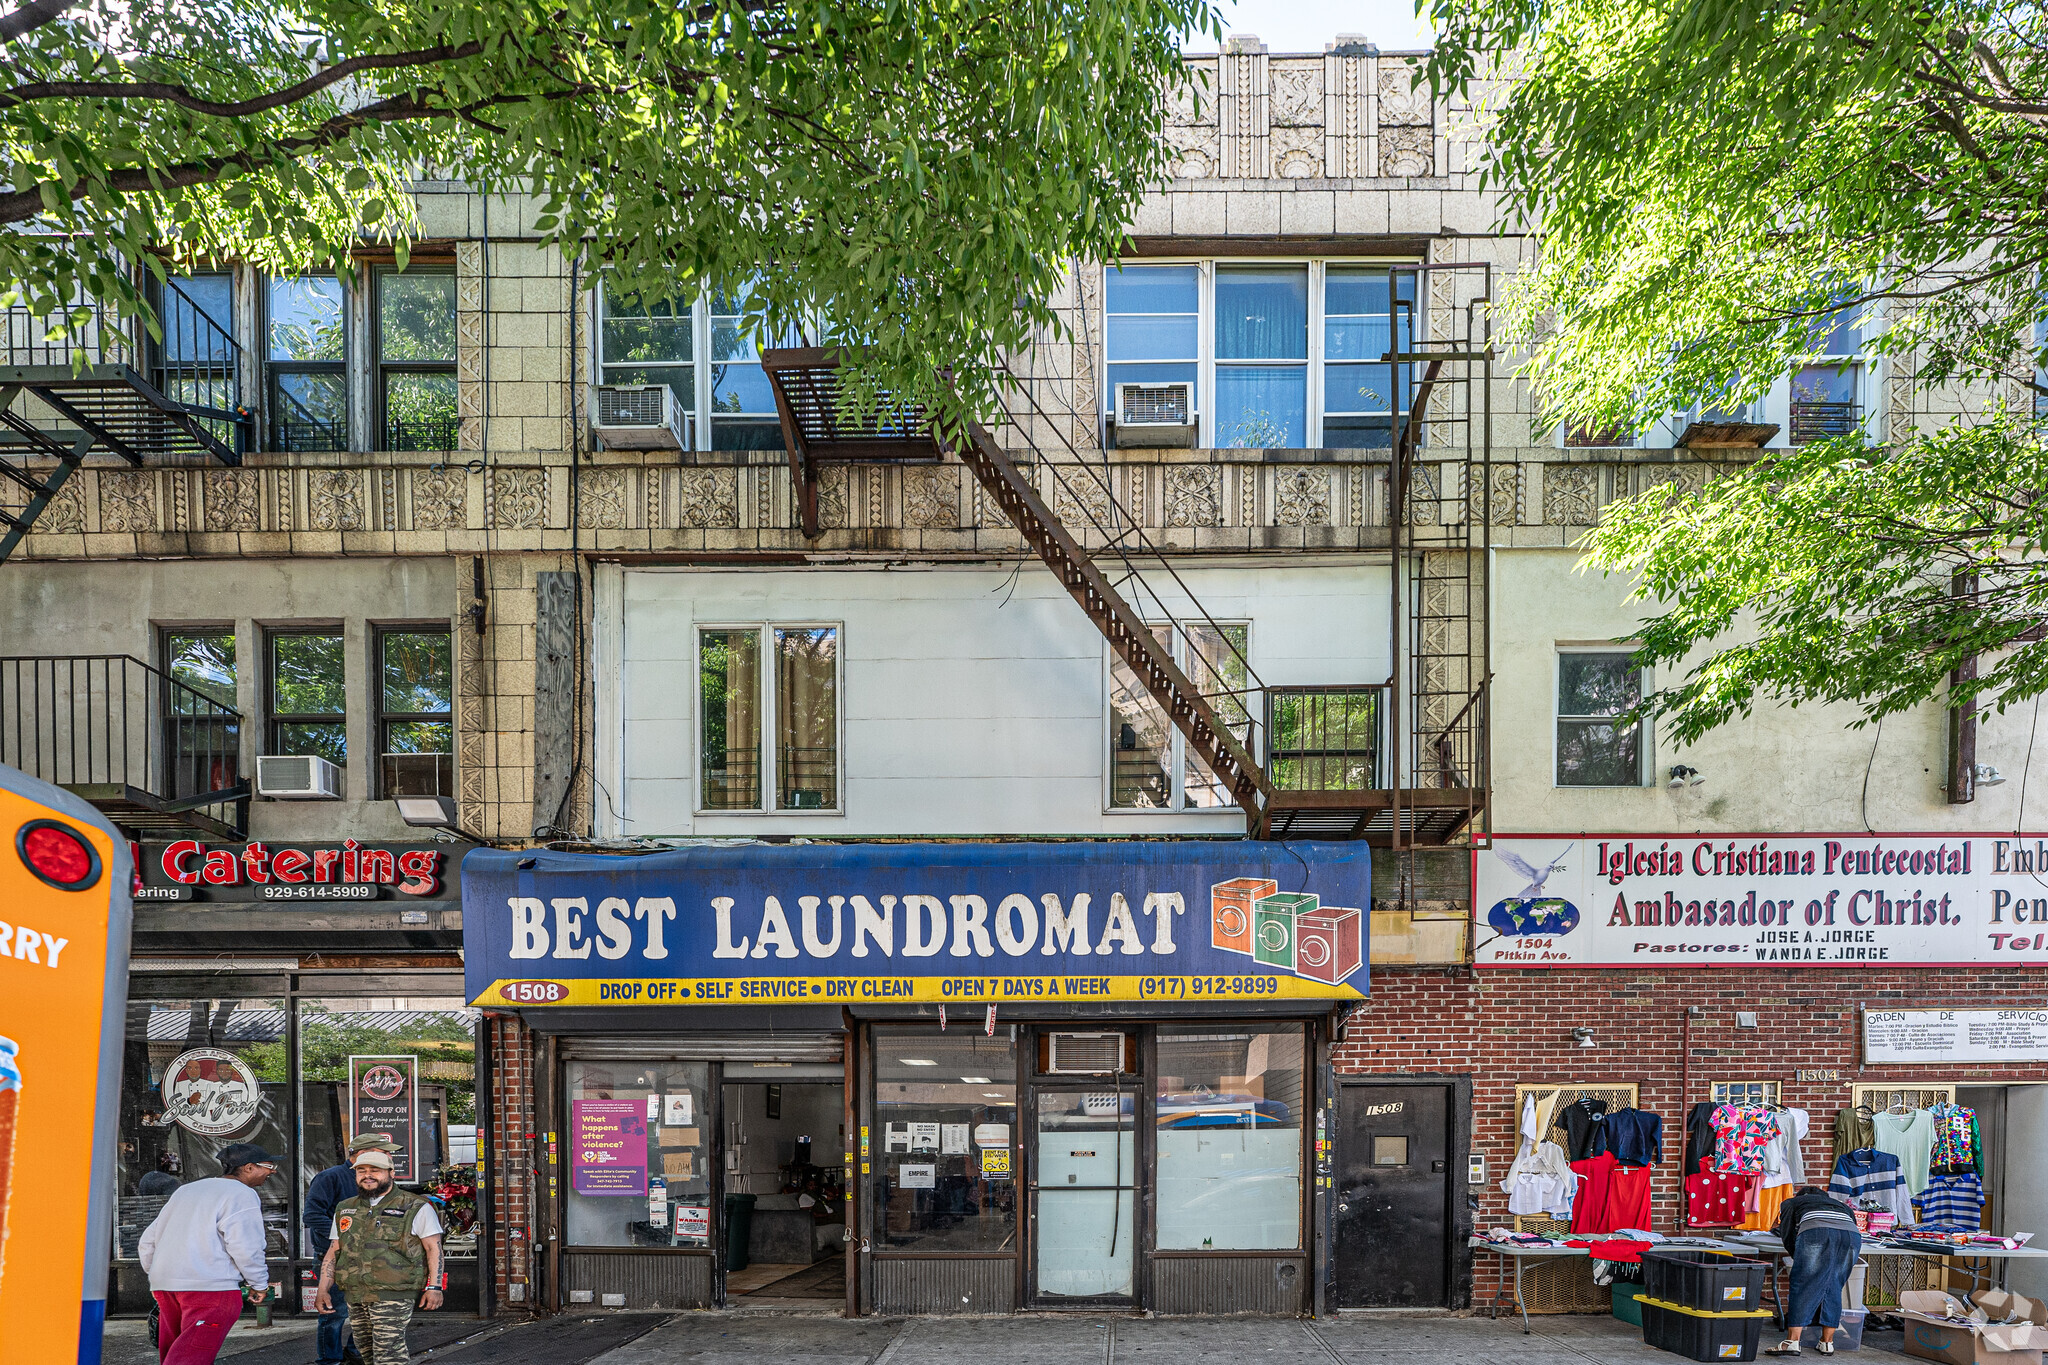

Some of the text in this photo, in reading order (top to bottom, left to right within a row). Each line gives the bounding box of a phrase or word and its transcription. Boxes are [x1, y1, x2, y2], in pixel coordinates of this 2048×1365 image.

[161, 838, 441, 896] Catering
[1597, 841, 1972, 885] Iglesia Cristiana Pentecostal
[137, 887, 180, 899] ering
[264, 886, 369, 899] 929-614-5909
[1606, 889, 1961, 927] Ambasador of Christ.
[507, 892, 1185, 960] BEST LAUNDROMAT
[1756, 931, 1799, 943] JOSE
[1515, 938, 1552, 949] 1504
[1633, 943, 1750, 953] Pastores:
[1495, 951, 1571, 960] Pitkin Ave.
[1756, 948, 1811, 960] WANDA
[507, 984, 559, 1001] 1508
[600, 977, 1278, 1000] DROP OFF SELF SERVICE DRY CLEAN OPEN 7 DAYS A WEEK (917) 912-9899
[1868, 1010, 2048, 1024] ORDEN DE SERVICIO
[1801, 1069, 1837, 1080] 1504
[361, 1106, 407, 1114] 10% OFF ON
[1366, 1102, 1404, 1116] 1508
[581, 1115, 606, 1123] What
[581, 1124, 619, 1133] happens
[581, 1132, 605, 1140] after
[665, 1164, 676, 1173] NO
